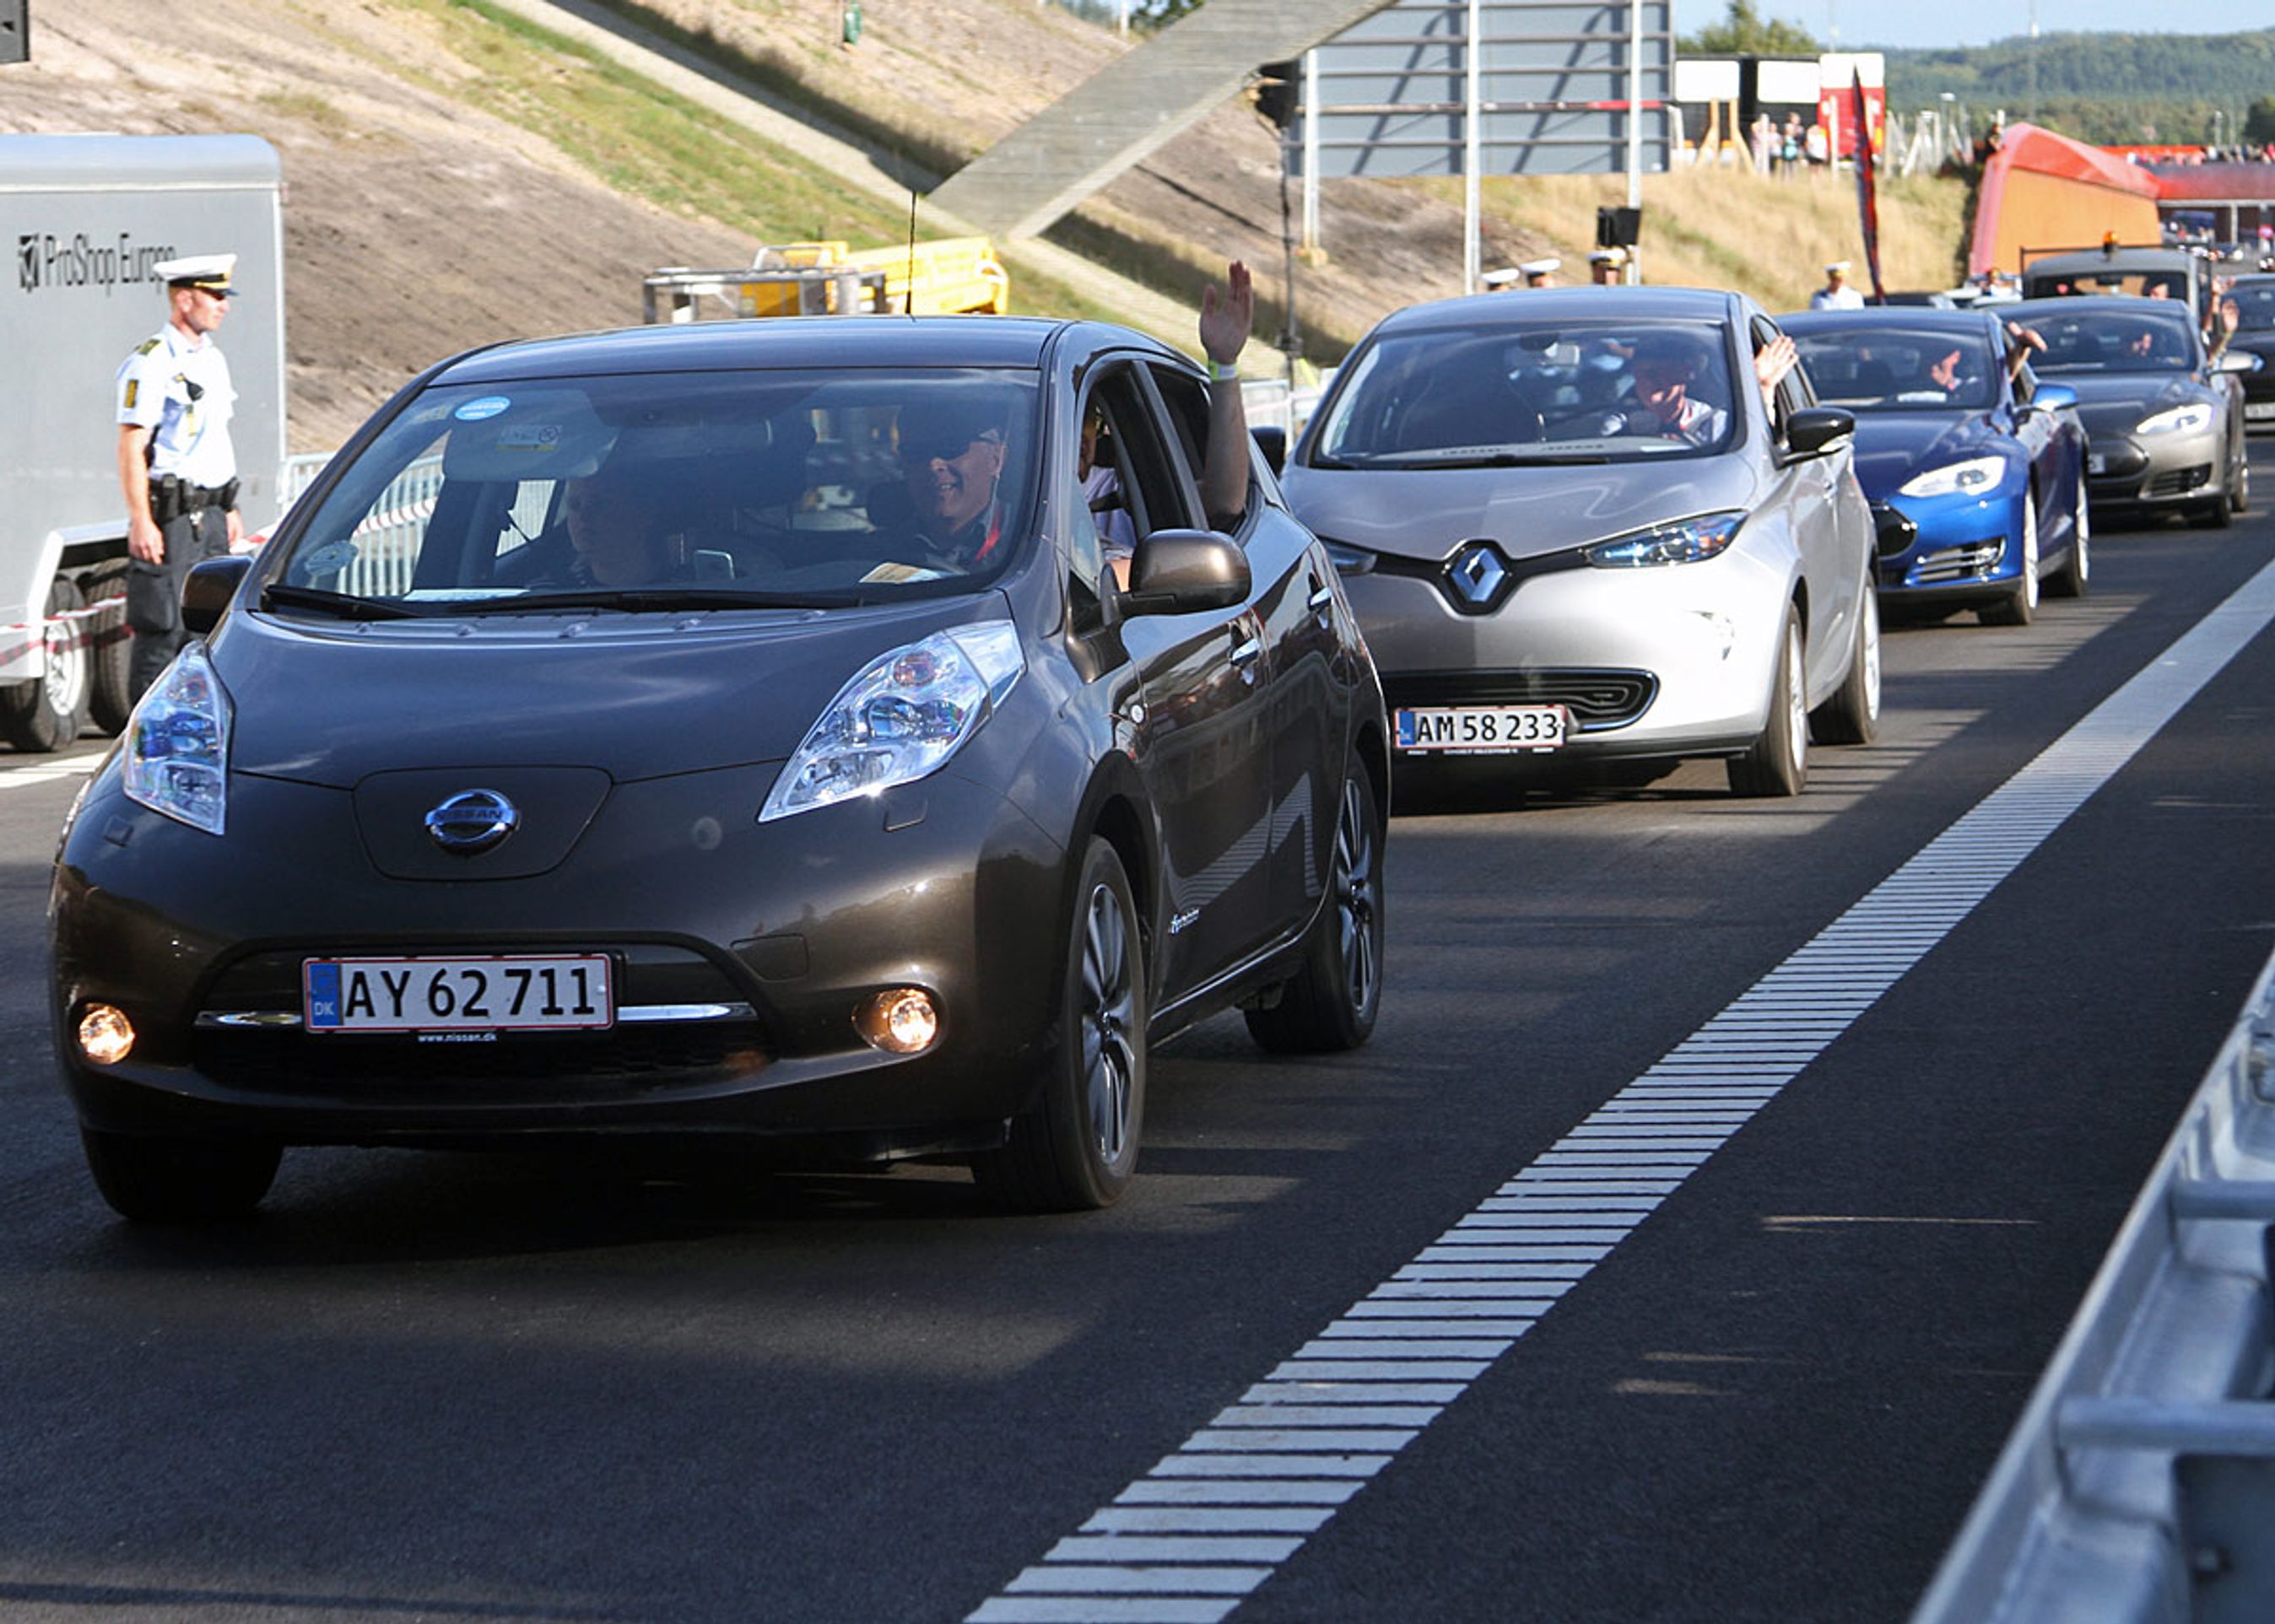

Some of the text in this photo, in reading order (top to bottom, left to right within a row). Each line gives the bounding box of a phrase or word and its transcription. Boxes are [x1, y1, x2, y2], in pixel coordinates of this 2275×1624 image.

[45, 233, 117, 297] ProShop
[1418, 714, 1558, 742] AM 58 233
[345, 968, 595, 1017] AY 62 711
[314, 1001, 334, 1016] DK
[418, 1033, 497, 1043] www.nissan.dk
